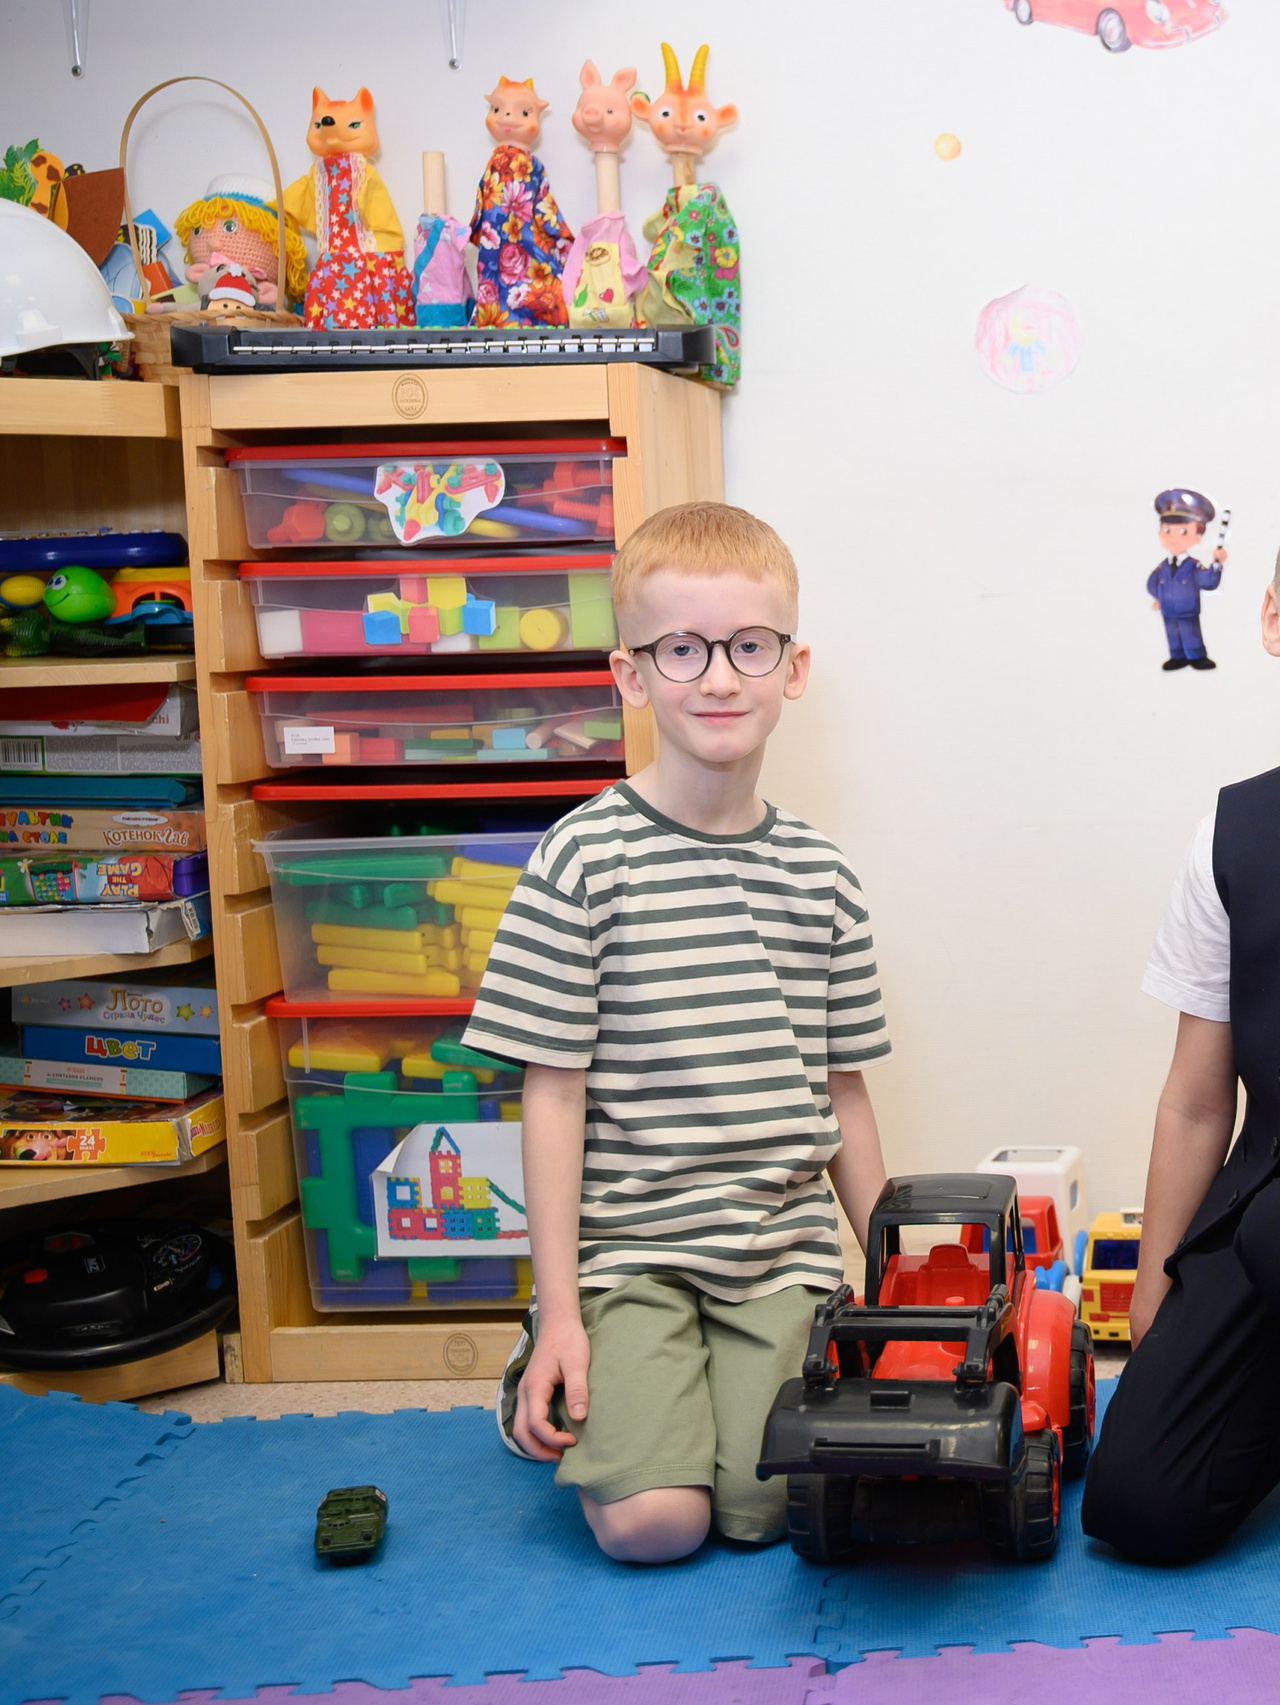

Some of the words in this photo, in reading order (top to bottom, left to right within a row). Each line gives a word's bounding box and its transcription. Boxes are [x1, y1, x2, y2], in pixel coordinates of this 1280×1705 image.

[22, 831, 67, 844] СТОЛЕ
[97, 862, 143, 876] GAME
[101, 884, 139, 898] PLAY
[79, 1135, 96, 1146] 24
